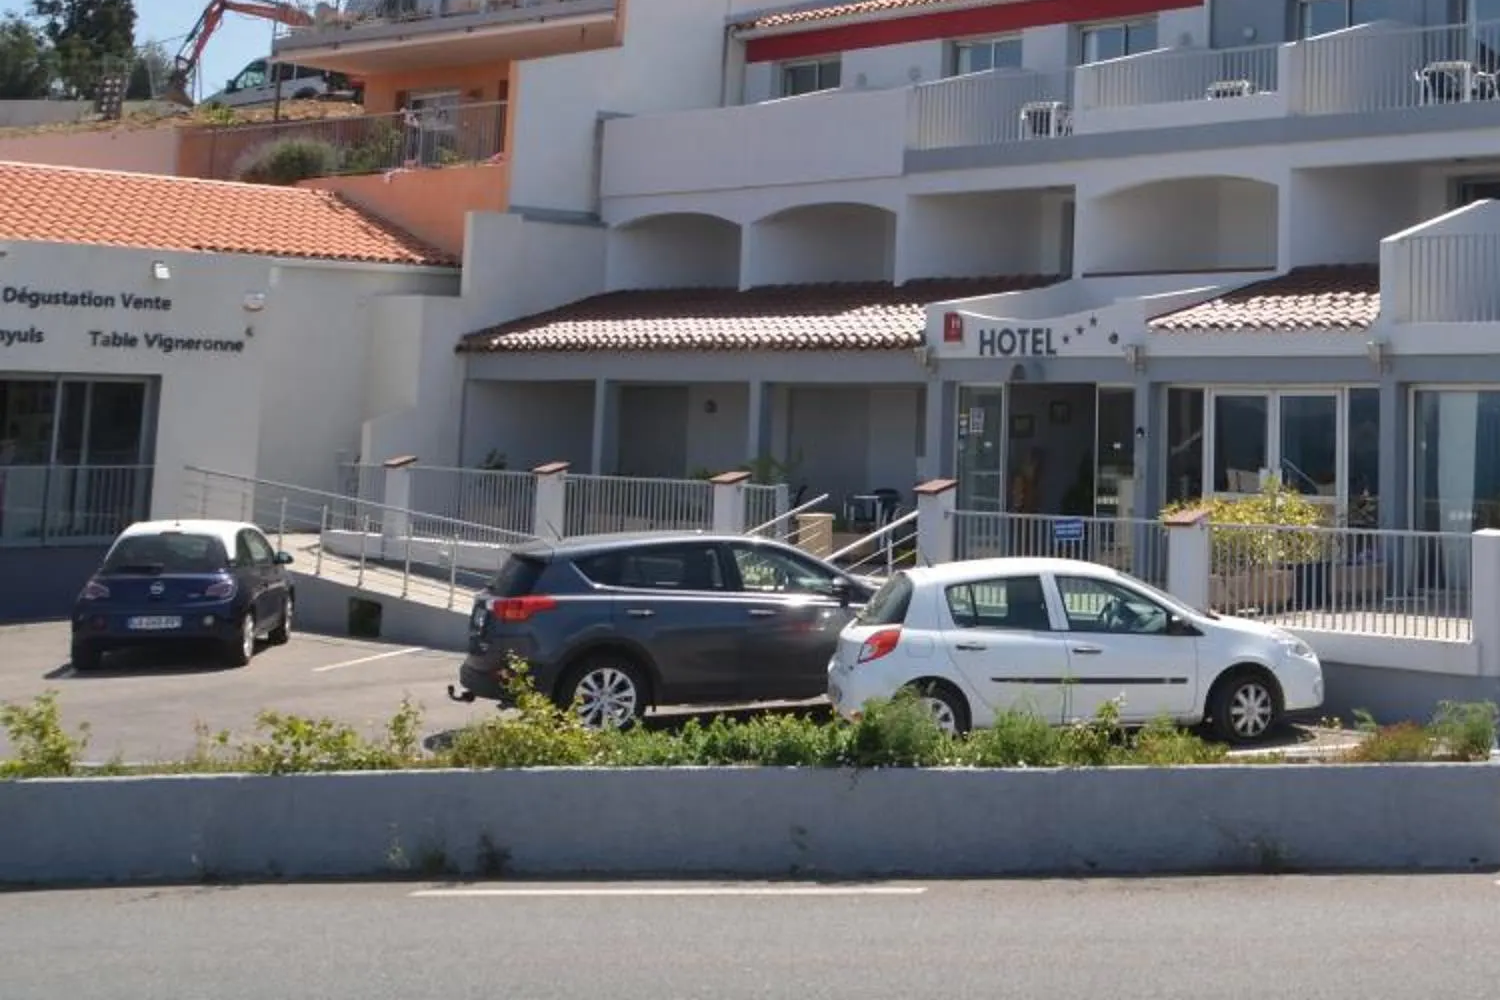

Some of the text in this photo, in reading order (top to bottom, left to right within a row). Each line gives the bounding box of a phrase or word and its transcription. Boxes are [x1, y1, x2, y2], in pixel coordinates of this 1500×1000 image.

[3, 286, 172, 310] Dégustation Vente
[88, 330, 244, 353] Table Vigneronne
[979, 328, 1057, 356] HOTEL
